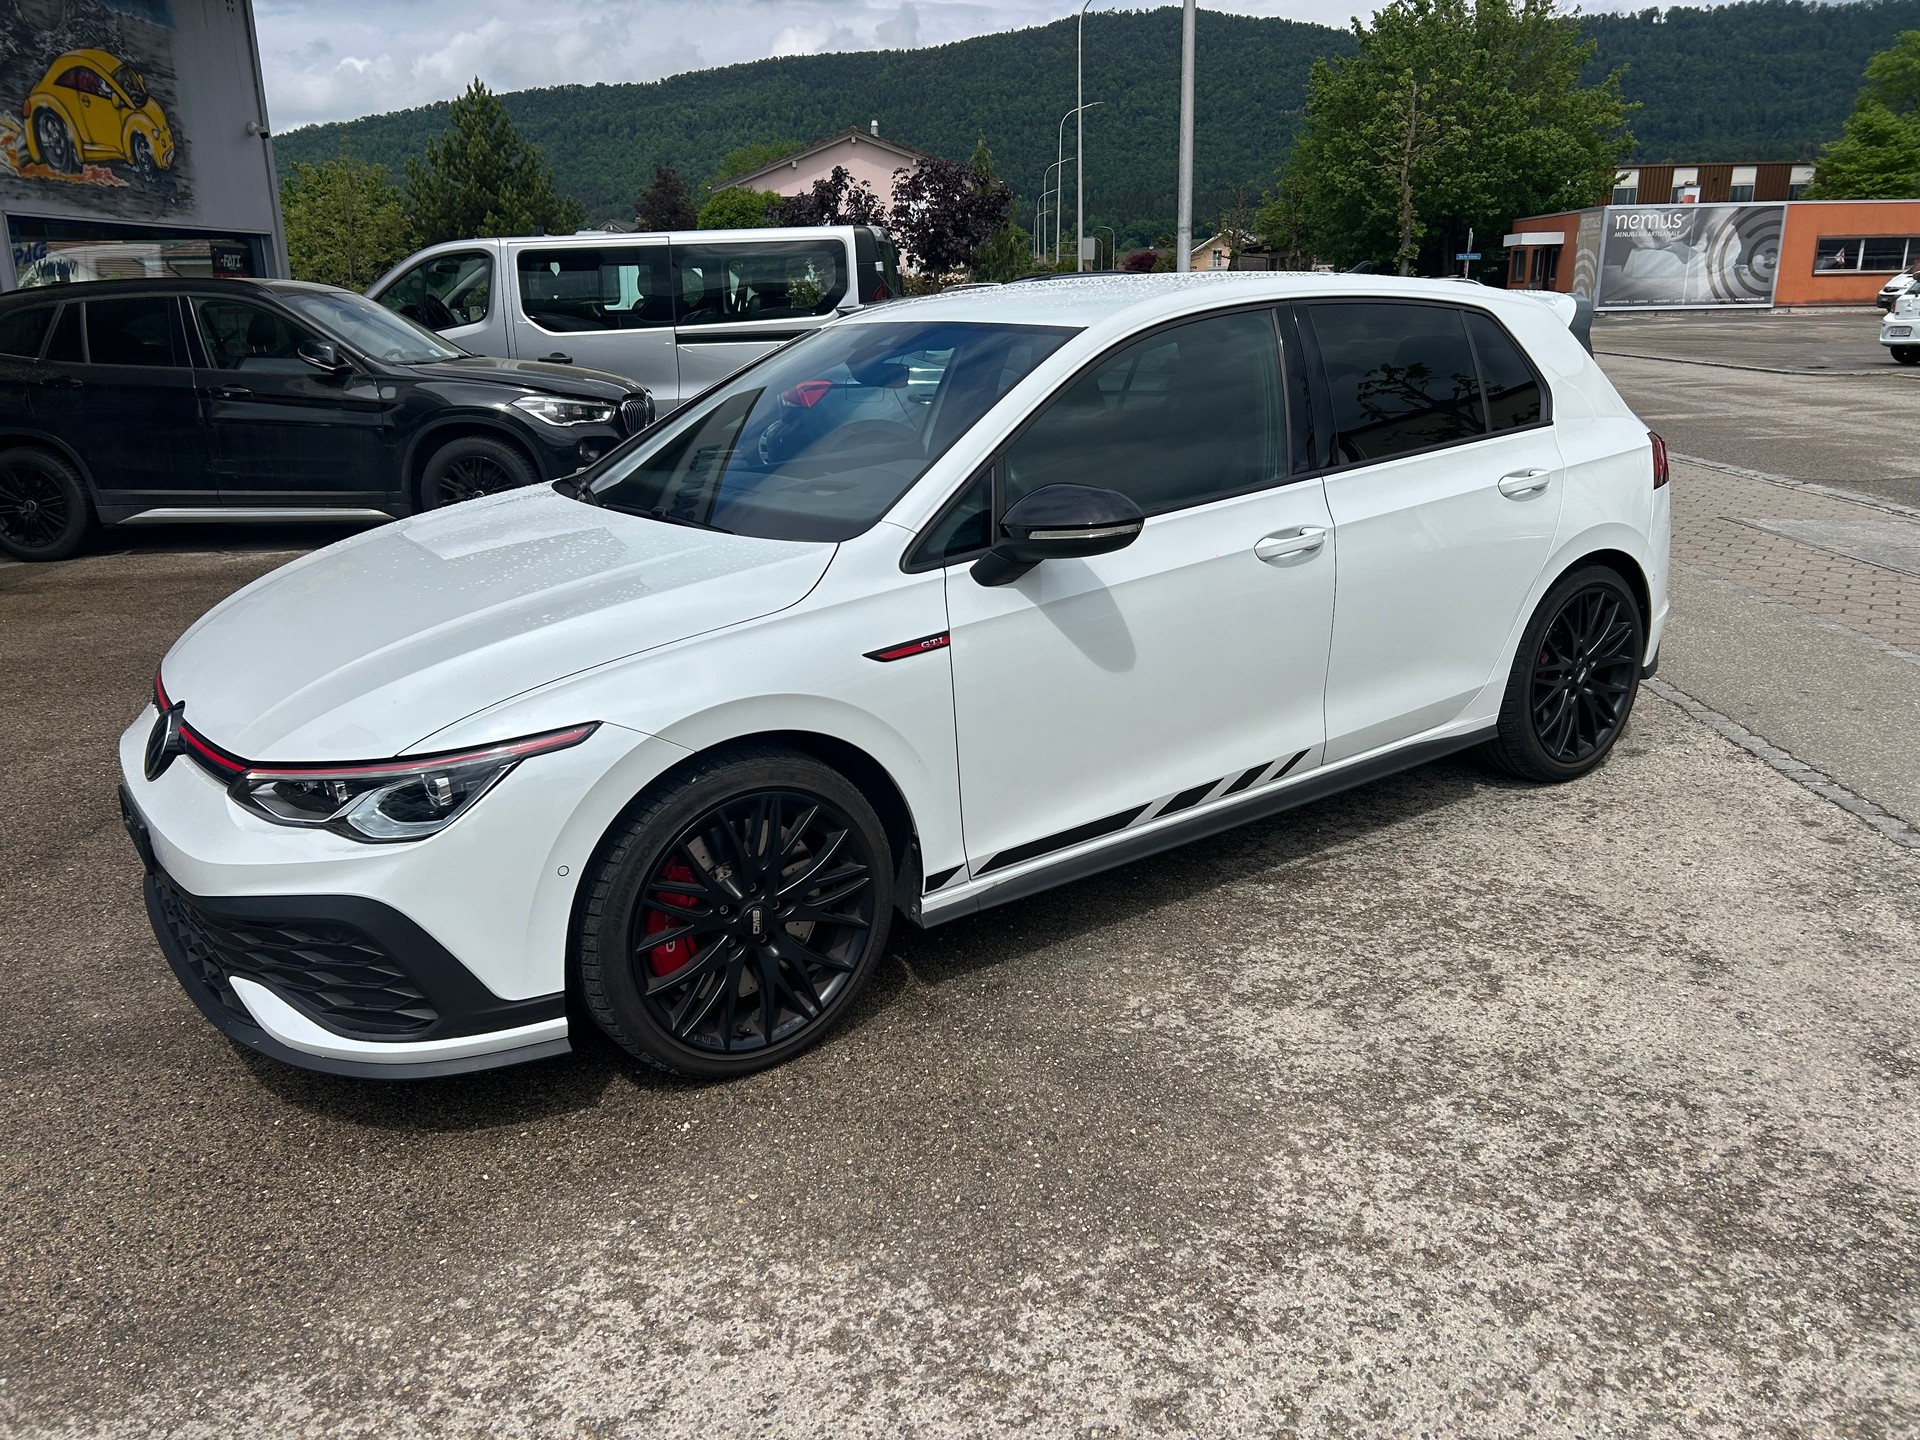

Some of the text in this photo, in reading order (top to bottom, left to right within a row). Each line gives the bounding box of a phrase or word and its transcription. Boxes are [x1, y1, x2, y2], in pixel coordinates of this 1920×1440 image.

[1615, 213, 1683, 230] nemus
[921, 636, 944, 648] GTI
[752, 910, 760, 935] CMS
